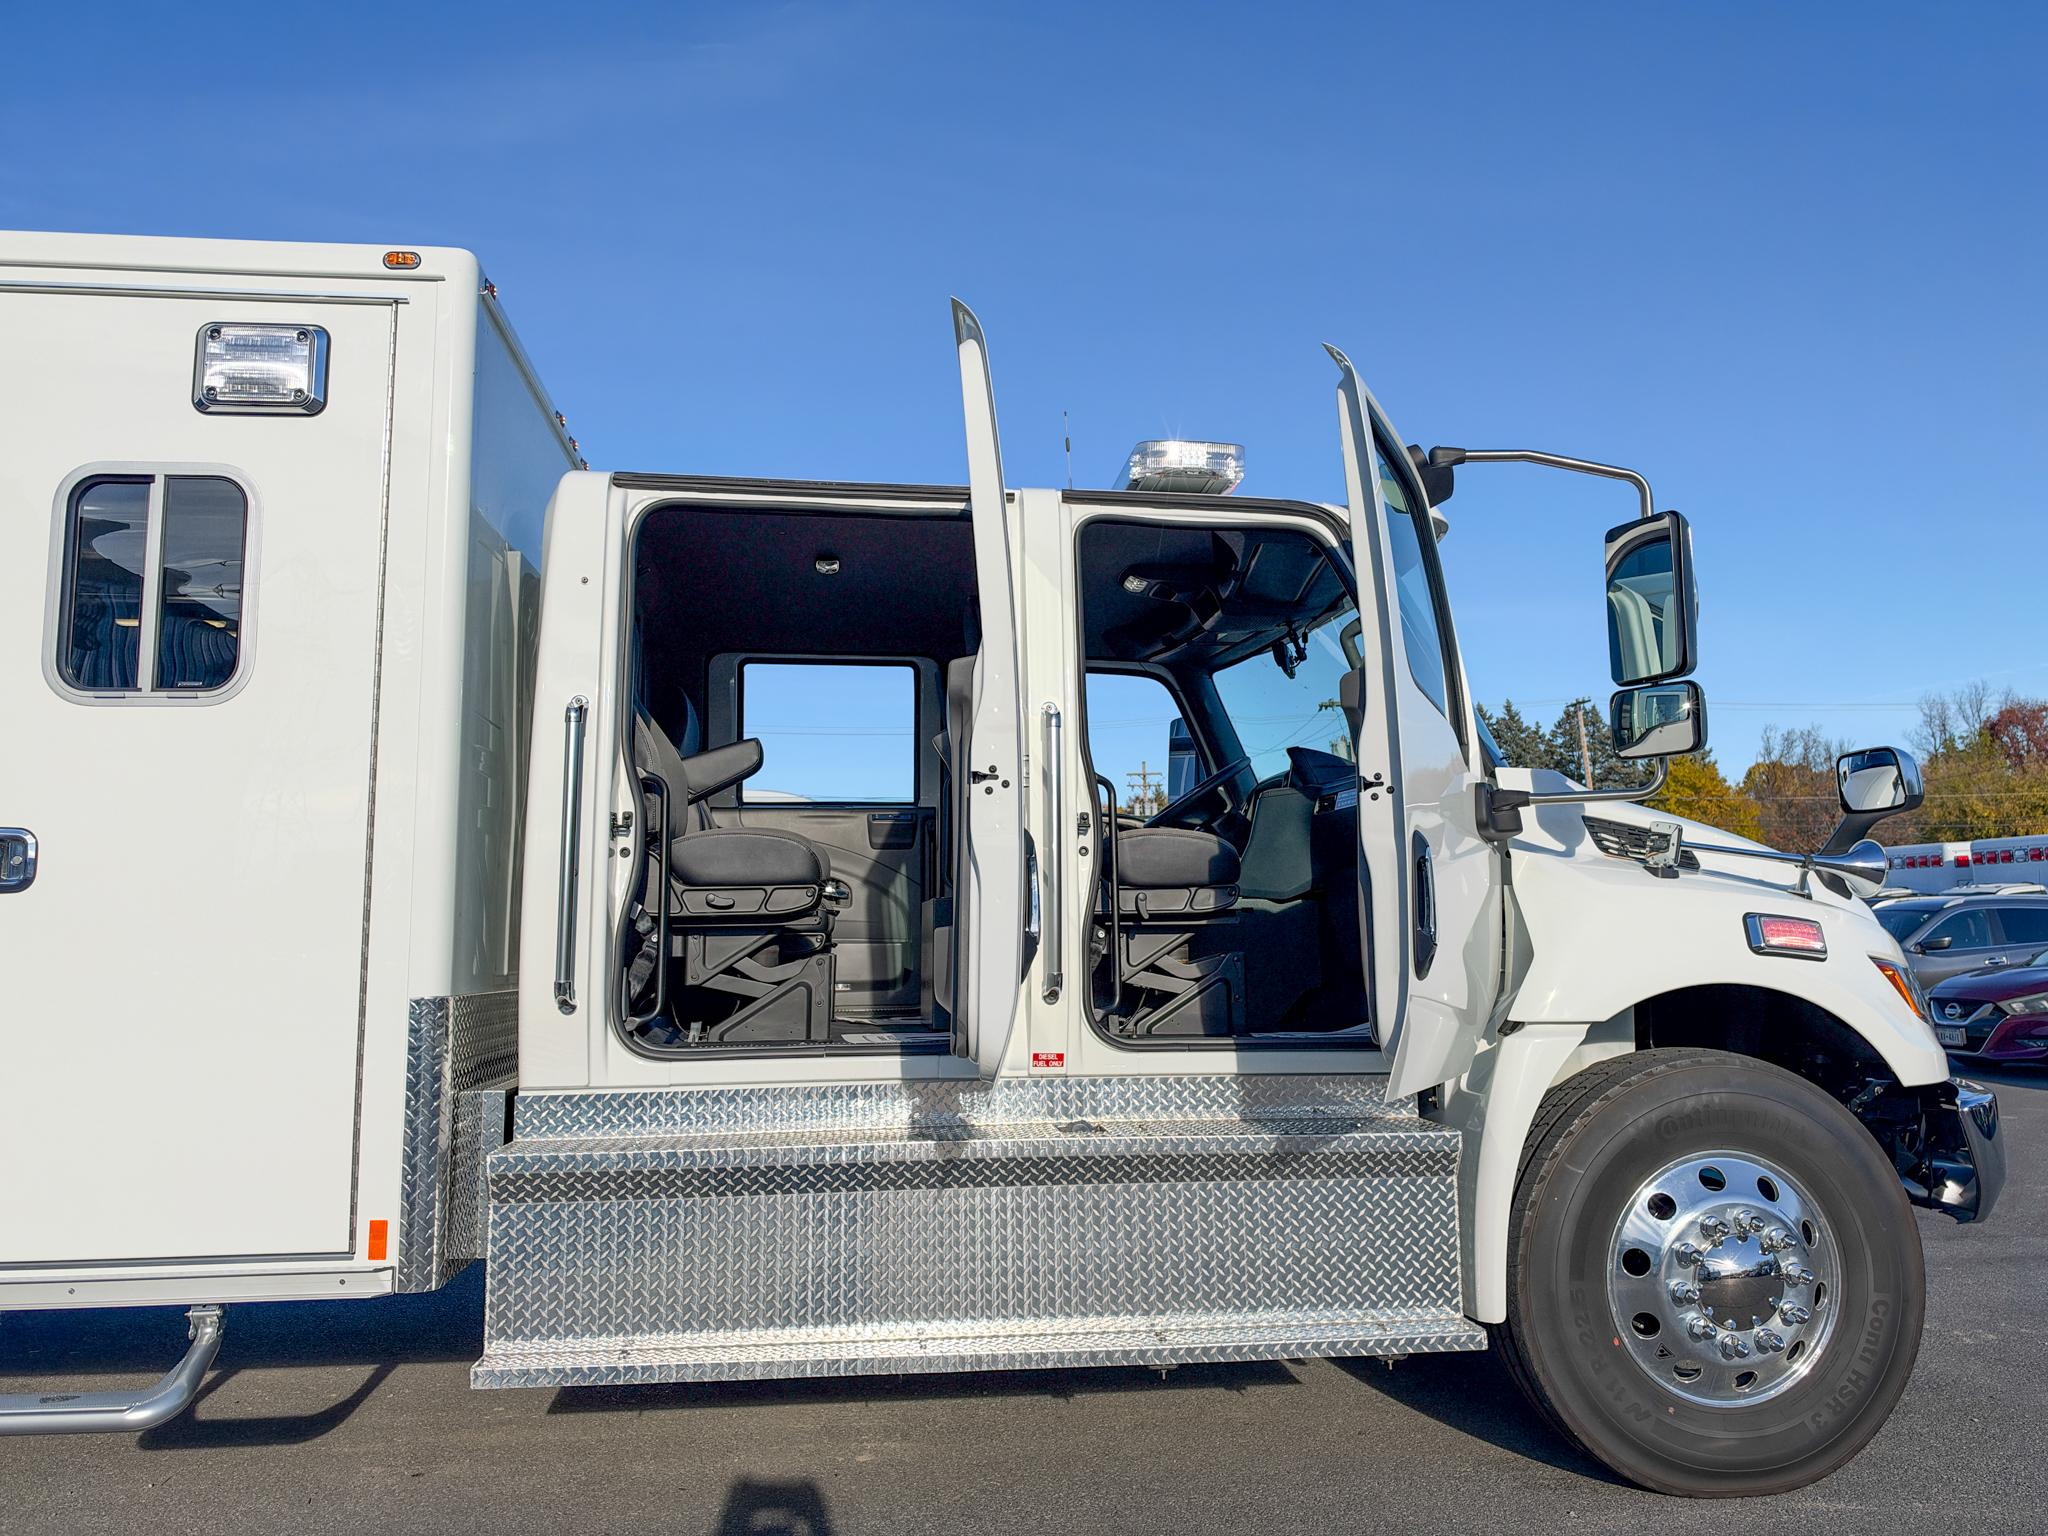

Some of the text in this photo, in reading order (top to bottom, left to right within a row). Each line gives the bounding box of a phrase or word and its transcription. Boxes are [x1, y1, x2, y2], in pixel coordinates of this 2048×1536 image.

[1810, 1299, 1890, 1430] Conti HSR 3
